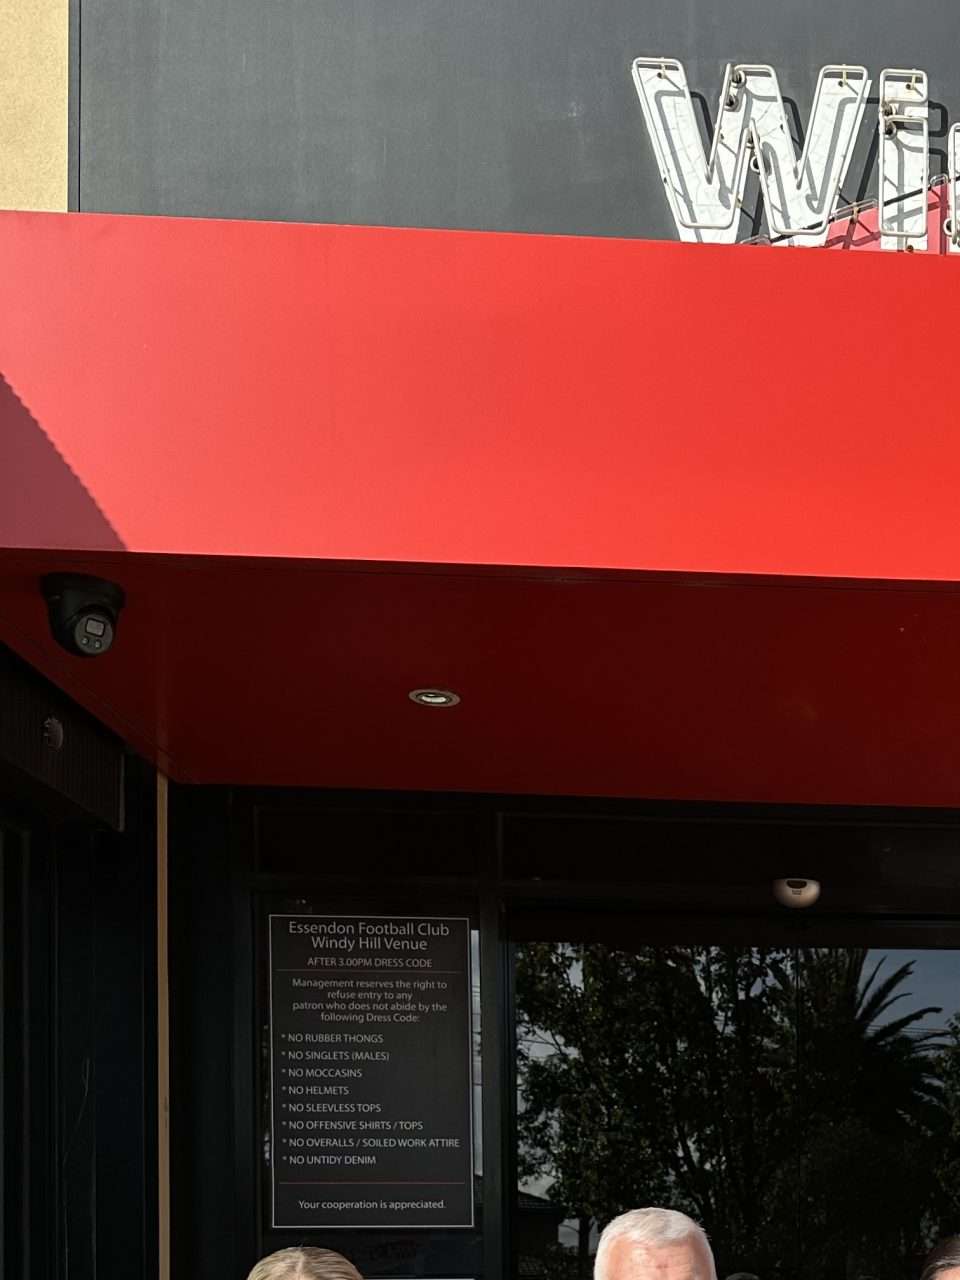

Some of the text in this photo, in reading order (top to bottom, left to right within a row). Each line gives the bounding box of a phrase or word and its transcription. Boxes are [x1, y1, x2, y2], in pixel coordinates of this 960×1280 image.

[289, 922, 449, 936] Essendon Football Club
[311, 937, 427, 952] Windy Hill Venue
[308, 958, 432, 967] AFTER 3.00PM DRESS CODE
[289, 1034, 383, 1043] NO RUBBER THONGS
[289, 1051, 389, 1061] NO SINGLETS (MALES)
[289, 1069, 362, 1078] NO MOCCASINS
[289, 1086, 349, 1095] NO HELMETS
[289, 1103, 381, 1112] NO SLEEVLESS TOPS
